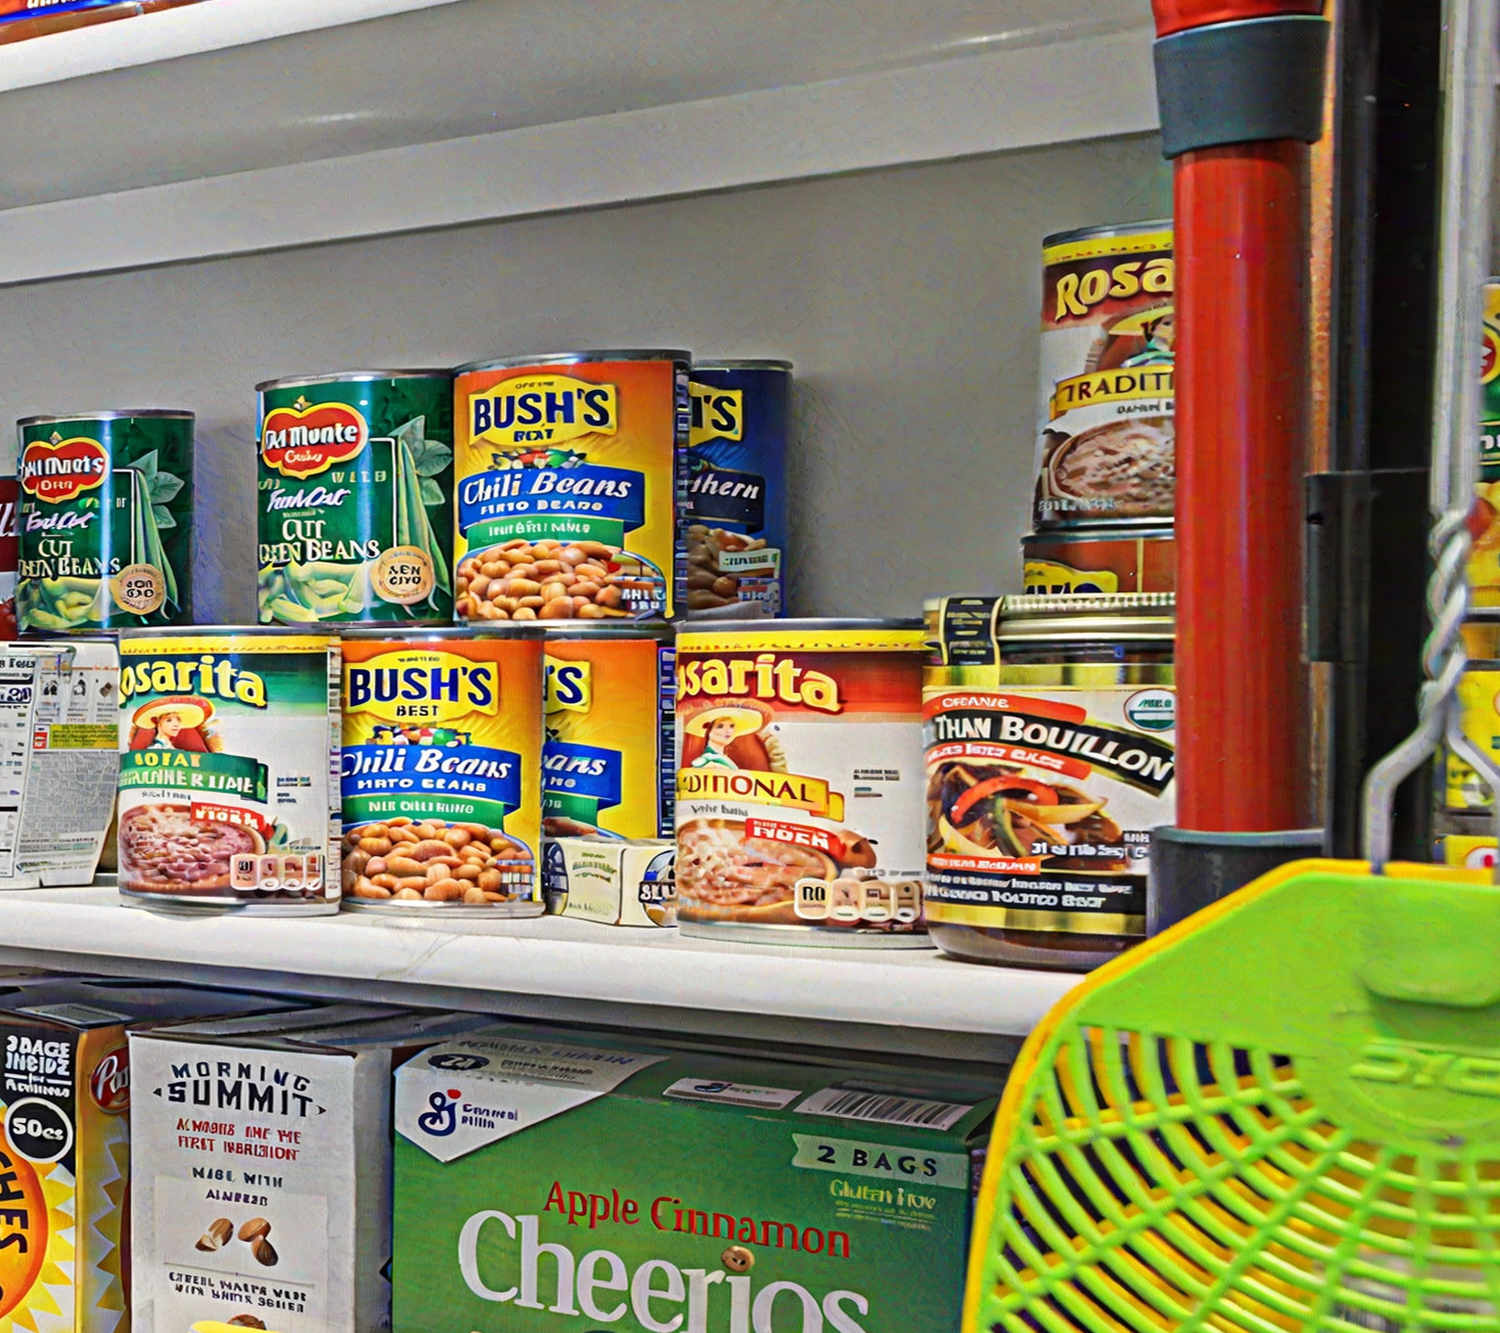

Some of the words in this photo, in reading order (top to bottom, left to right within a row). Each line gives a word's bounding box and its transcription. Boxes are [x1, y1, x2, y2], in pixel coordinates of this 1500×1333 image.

[472, 384, 614, 433] BUSH'S
[464, 474, 520, 503] Chili
[530, 471, 631, 499] Beans
[305, 538, 380, 562] BEANS
[59, 557, 120, 578] BEANS
[350, 662, 493, 705] BUSH'S
[395, 703, 439, 718] BEST
[417, 749, 513, 779] Beans
[934, 716, 996, 743] THAN
[1001, 723, 1172, 785] BOUILLON
[170, 1059, 312, 1092] MORNING
[166, 1081, 315, 1119] SUMMIT
[815, 1144, 837, 1166] 2
[853, 1147, 939, 1178] BAGS
[543, 1180, 641, 1227] Apple
[650, 1194, 852, 1260] Cinnamon
